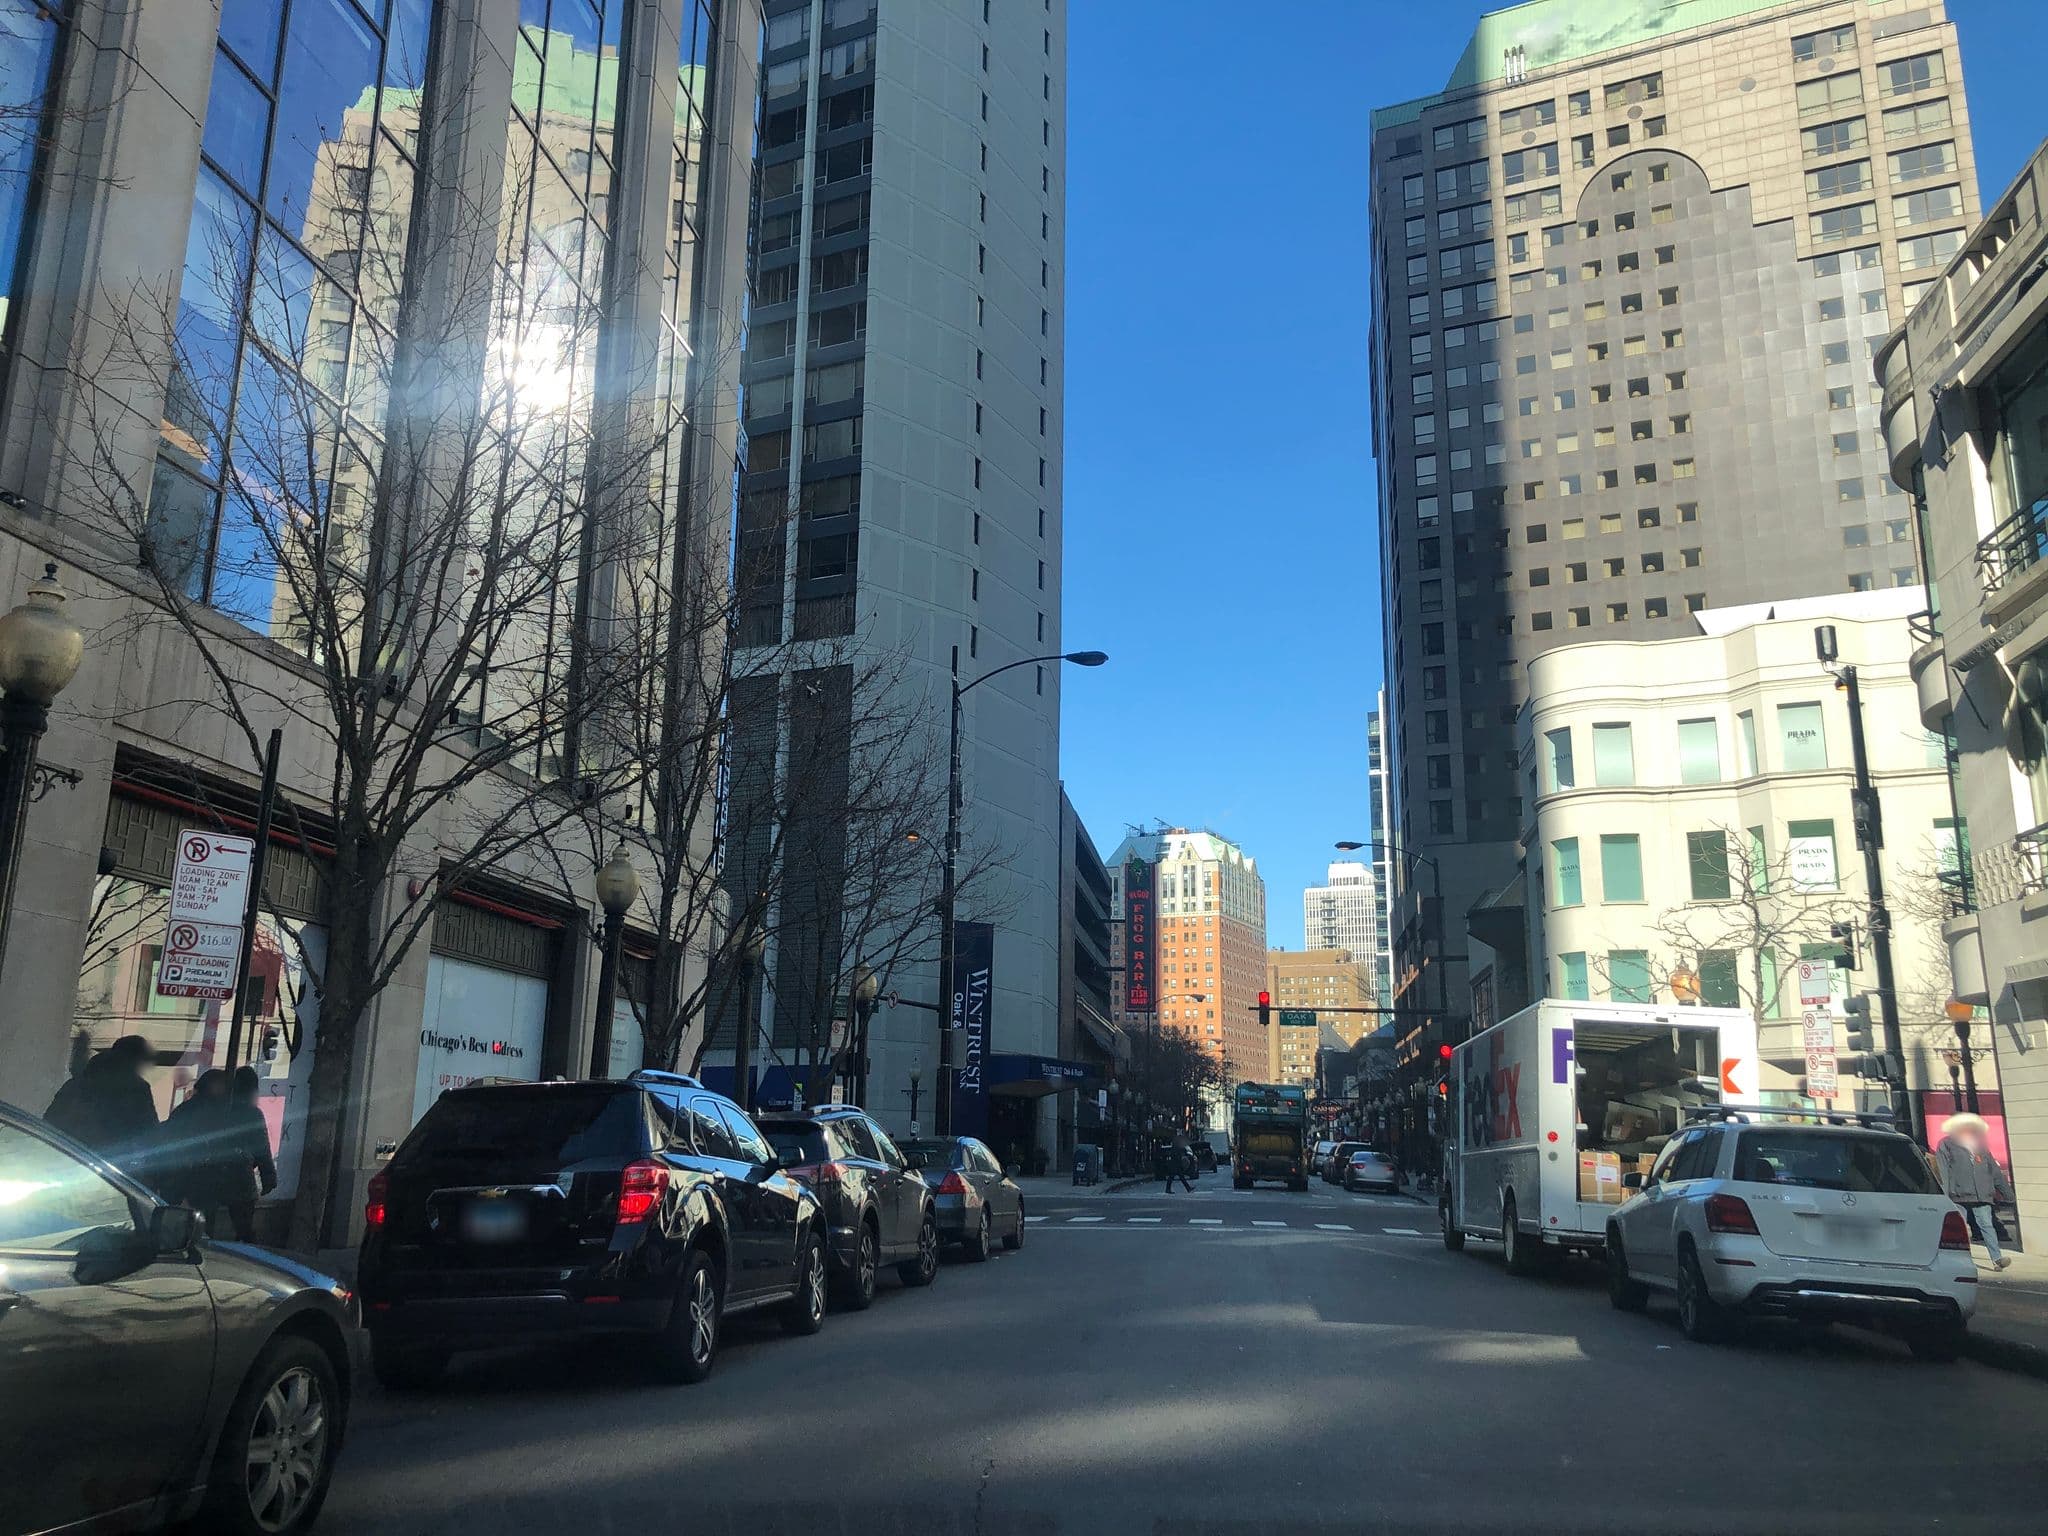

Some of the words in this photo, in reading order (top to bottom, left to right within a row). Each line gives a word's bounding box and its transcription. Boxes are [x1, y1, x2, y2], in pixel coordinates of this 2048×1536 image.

[1787, 729, 1816, 738] PRADA
[180, 867, 215, 878] LOADING
[219, 872, 241, 881] ZONE
[180, 875, 200, 884] 10AM
[178, 883, 196, 892] MON
[203, 886, 217, 895] SAT
[175, 900, 209, 911] SUNDAY
[1133, 903, 1145, 943] FROG
[199, 934, 232, 947] $16.00
[167, 955, 192, 966] VALET
[196, 958, 230, 969] LOADING
[1133, 951, 1145, 981] BAR
[185, 967, 222, 977] PREMIUM
[162, 984, 189, 996] TOW
[194, 987, 226, 999] ZONE
[953, 992, 964, 1017] Oak
[966, 967, 989, 1094] WINTRUST
[420, 1029, 467, 1055] Chicago's
[469, 1036, 487, 1054] Best
[439, 1073, 450, 1087] UP
[452, 1076, 464, 1088] TO
